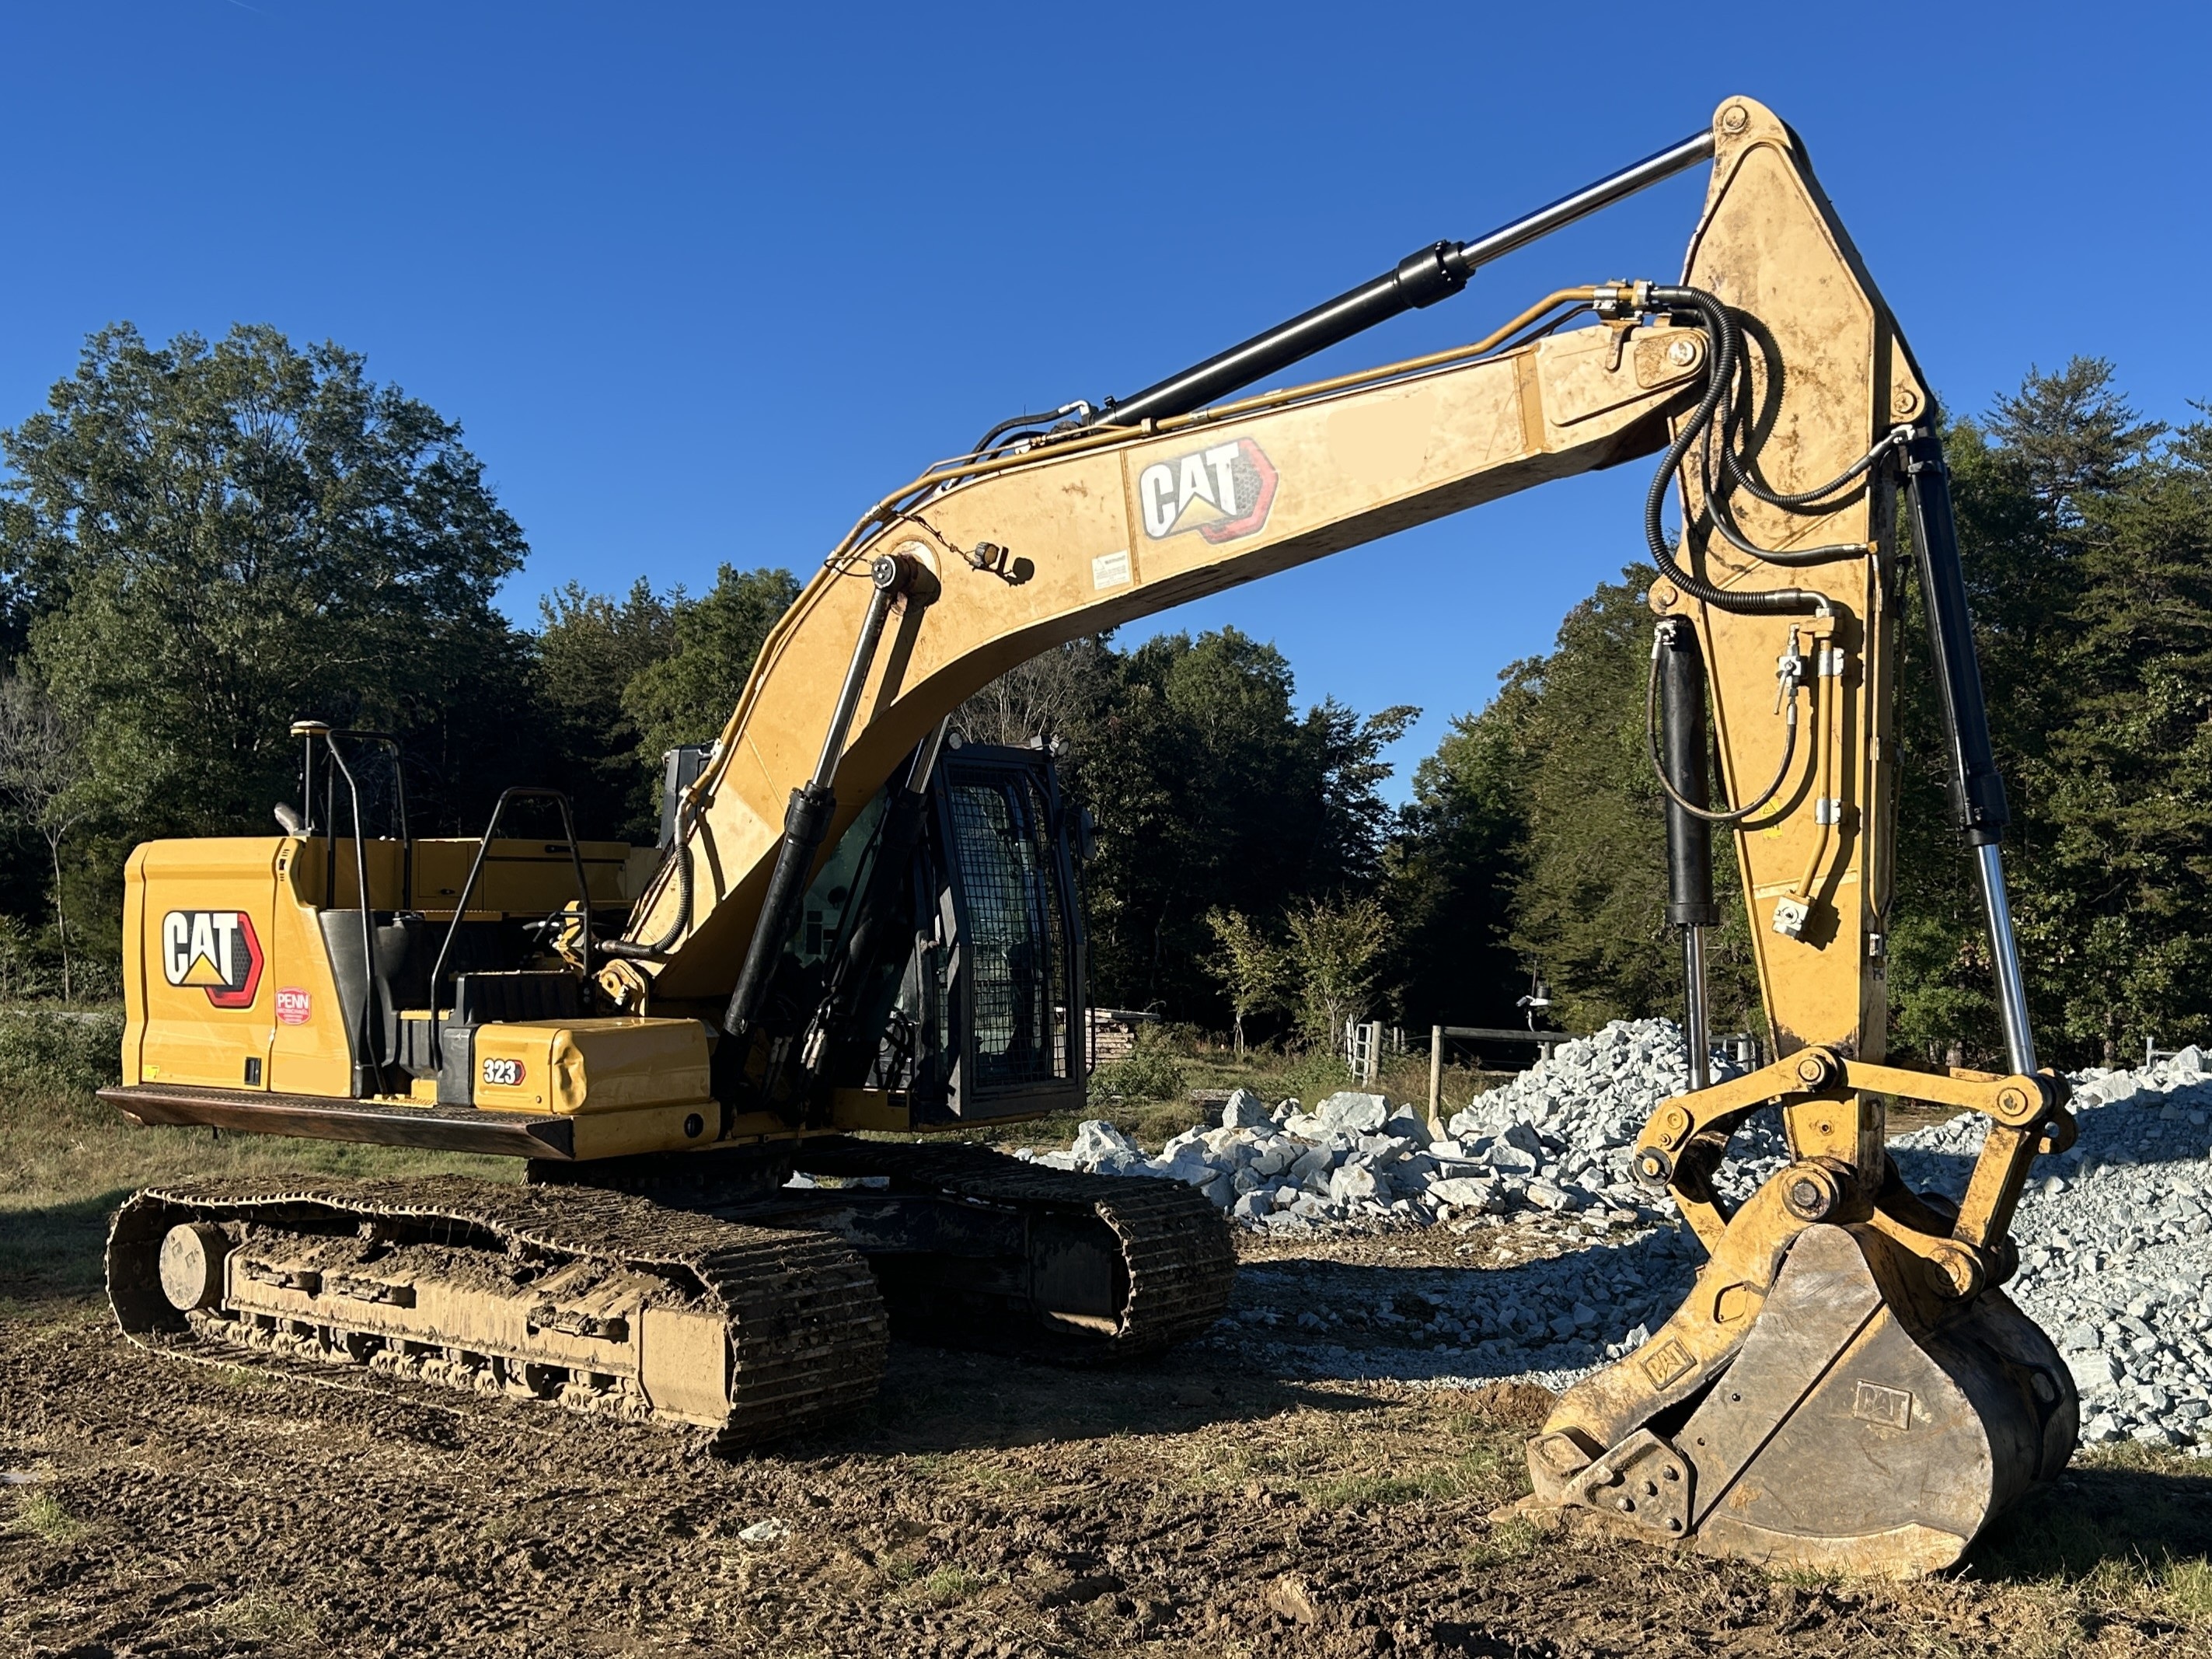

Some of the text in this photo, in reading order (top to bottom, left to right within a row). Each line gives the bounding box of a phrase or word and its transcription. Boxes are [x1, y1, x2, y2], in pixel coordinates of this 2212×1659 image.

[1141, 442, 1239, 537] CAT
[164, 912, 238, 986] CAT
[277, 994, 309, 1009] PENN
[483, 1059, 515, 1084] 323
[1645, 1342, 1687, 1385] CAT
[1858, 1386, 1907, 1423] CAT
